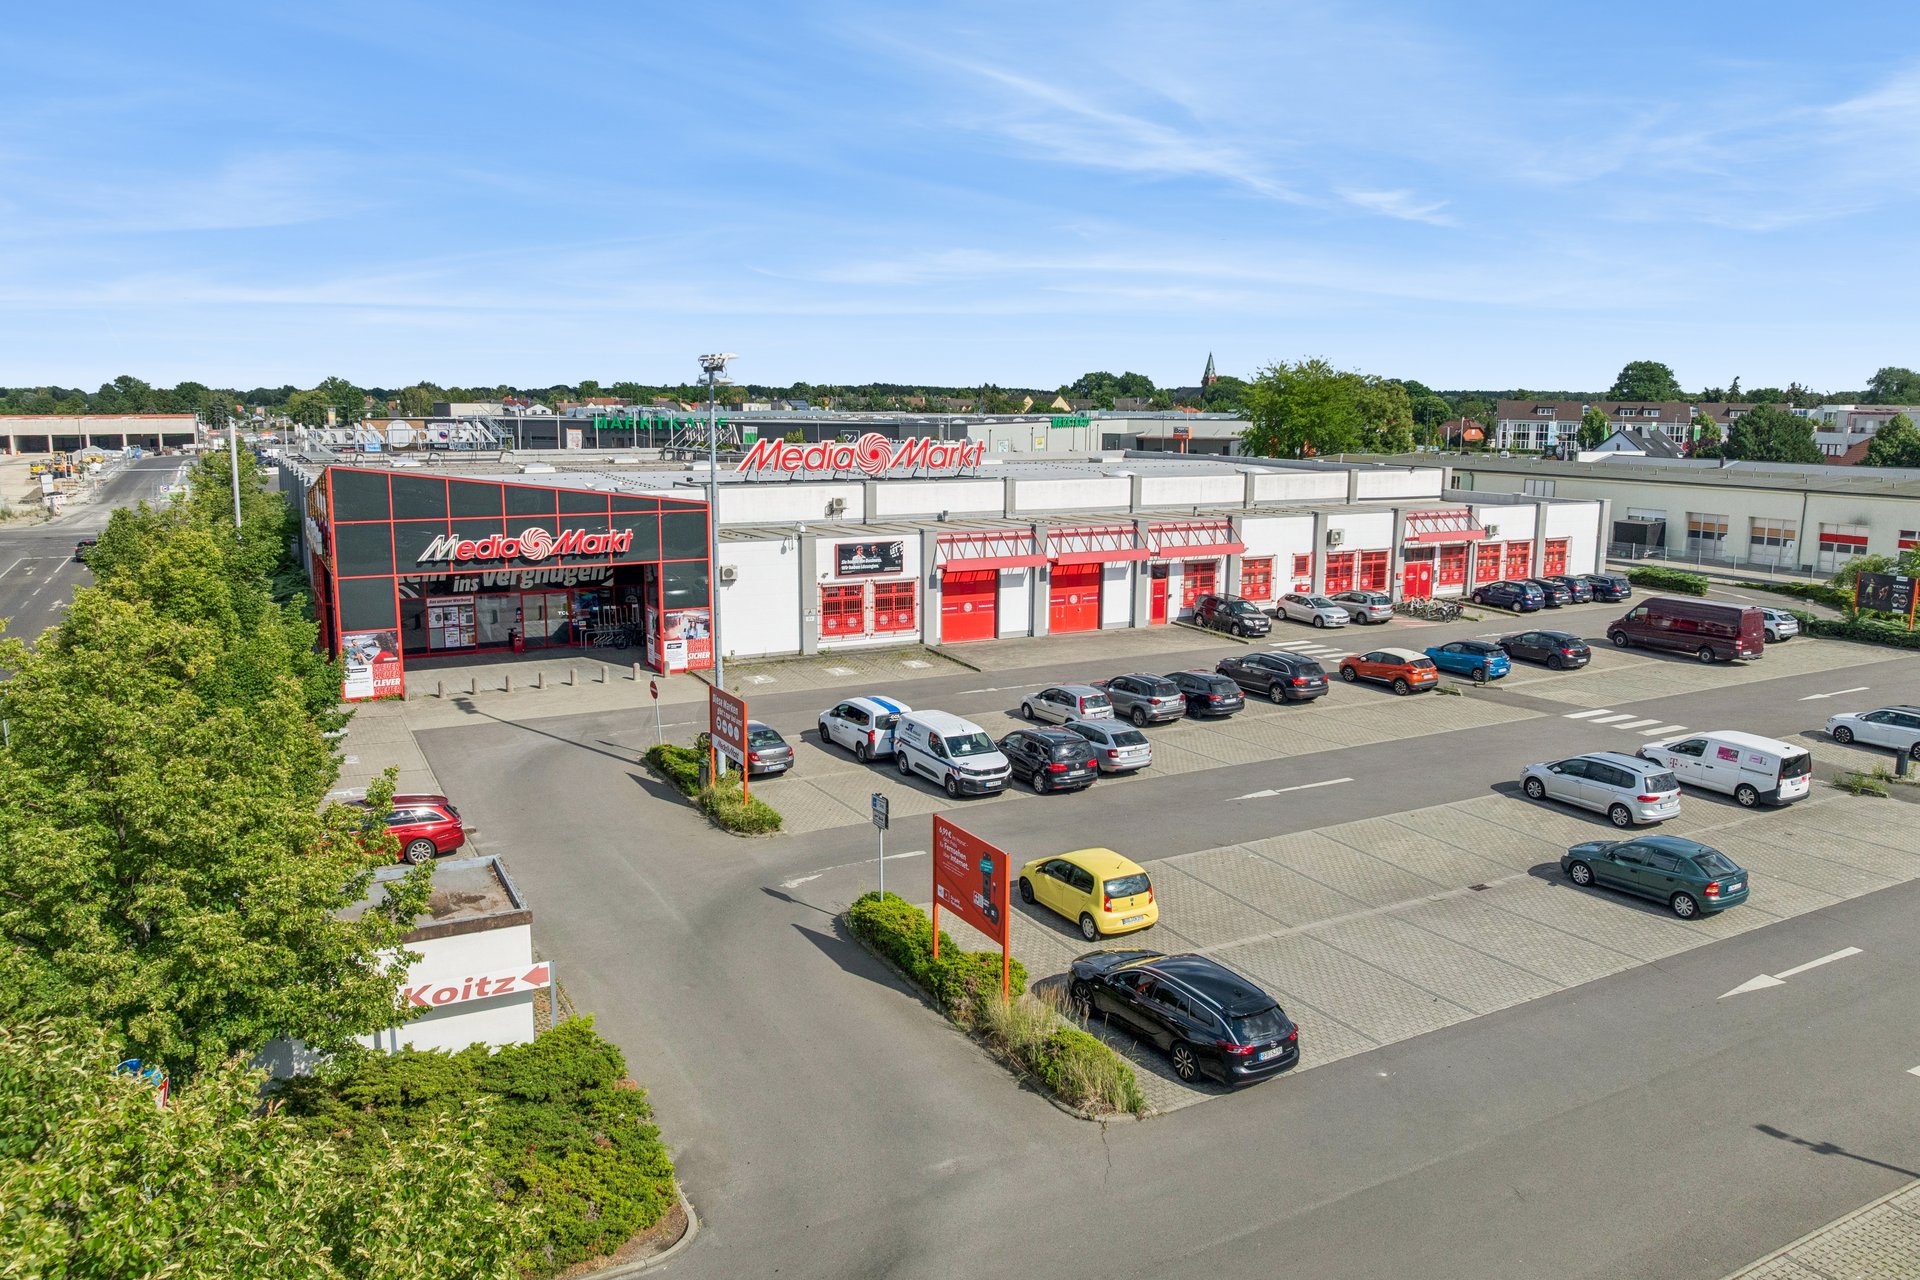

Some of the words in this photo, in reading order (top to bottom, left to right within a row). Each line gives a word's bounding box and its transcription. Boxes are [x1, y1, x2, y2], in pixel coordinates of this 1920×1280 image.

[735, 438, 856, 473] Media
[889, 437, 985, 470] Markt
[417, 534, 521, 562] Media
[549, 528, 634, 555] Markt
[453, 575, 480, 593] ins
[687, 651, 710, 660] SICHER
[374, 677, 401, 687] CLEVER
[944, 842, 966, 861] Fernsehen
[403, 976, 516, 1007] Koitz
